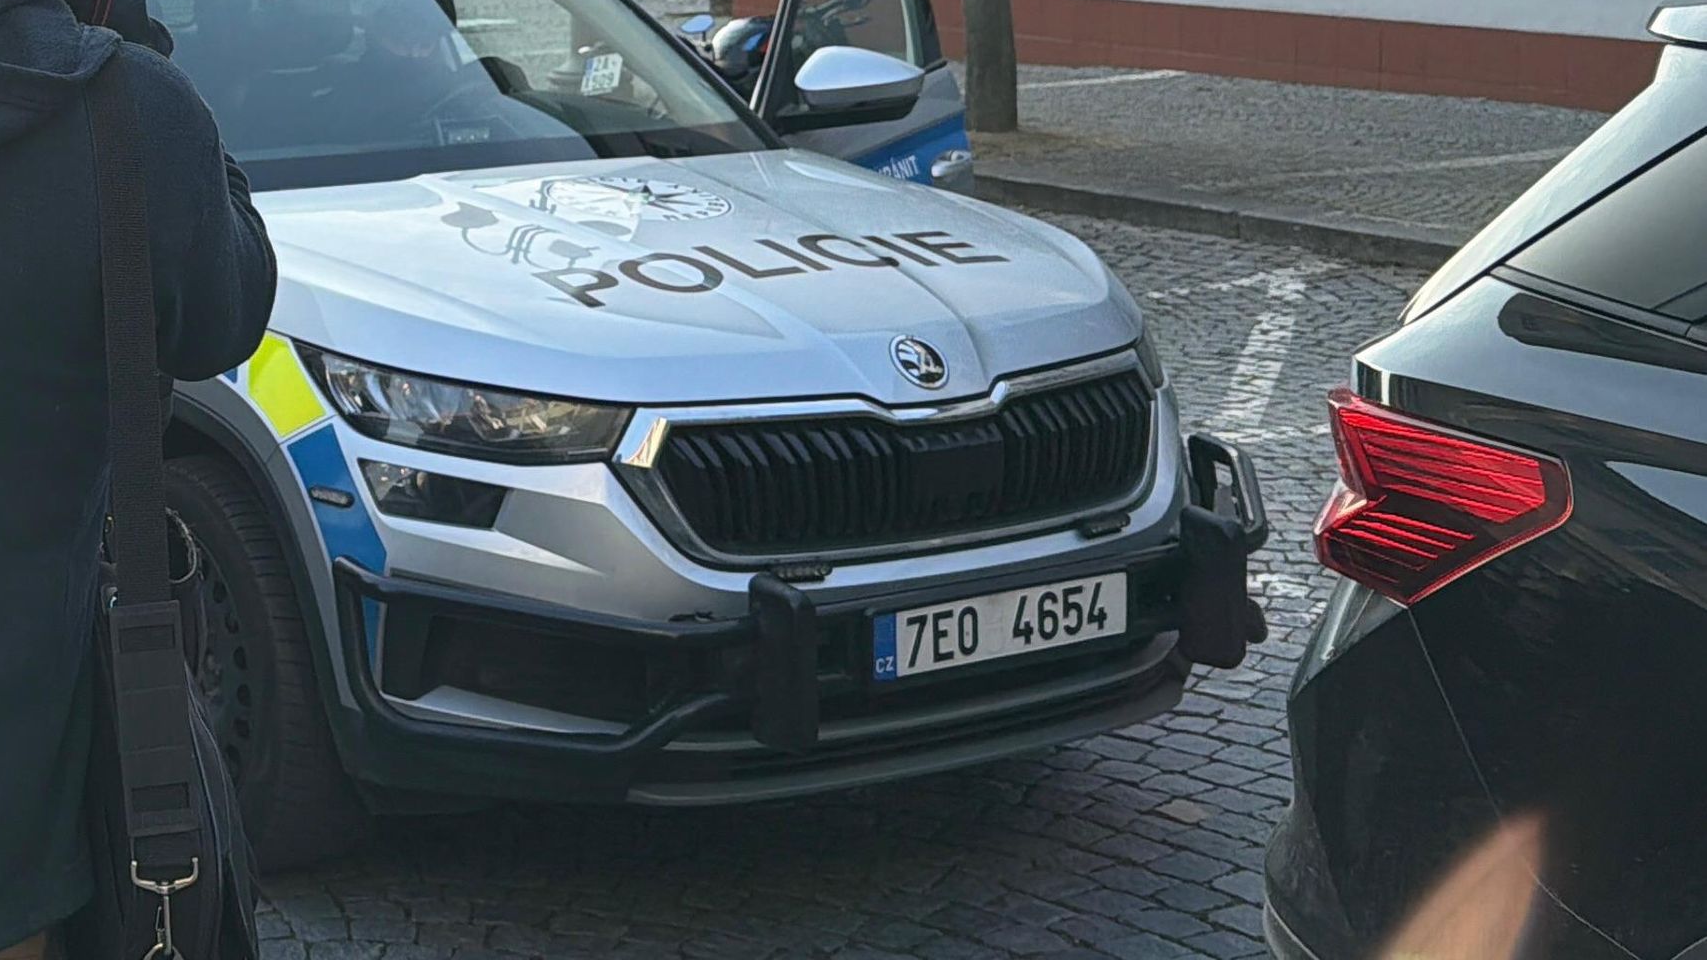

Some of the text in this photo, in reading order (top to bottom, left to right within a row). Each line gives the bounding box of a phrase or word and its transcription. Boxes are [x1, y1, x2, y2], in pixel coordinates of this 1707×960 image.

[532, 230, 1010, 308] POLICIE
[905, 581, 1108, 669] 7E0 4654
[875, 655, 895, 674] CZ
